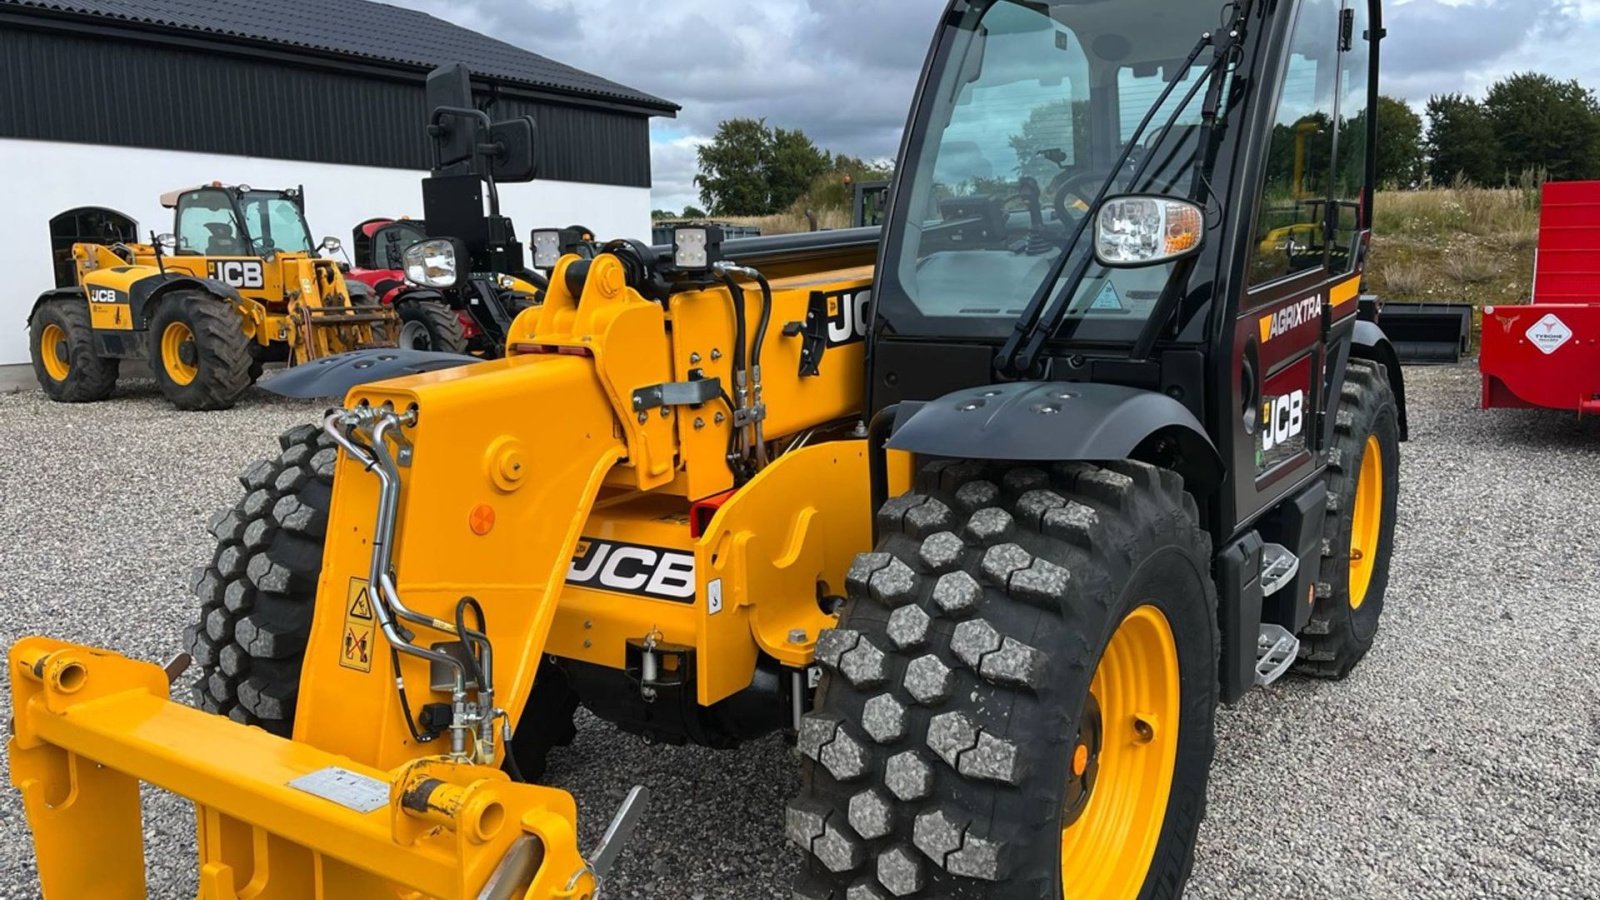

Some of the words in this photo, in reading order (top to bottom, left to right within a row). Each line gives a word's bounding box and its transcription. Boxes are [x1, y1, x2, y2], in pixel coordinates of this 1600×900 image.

[91, 290, 116, 302] JCB
[208, 261, 263, 287] JCB
[827, 289, 872, 342] JC
[1269, 293, 1322, 340] AGRIXTRA
[1262, 389, 1303, 451] JCB
[565, 543, 696, 598] JCB
